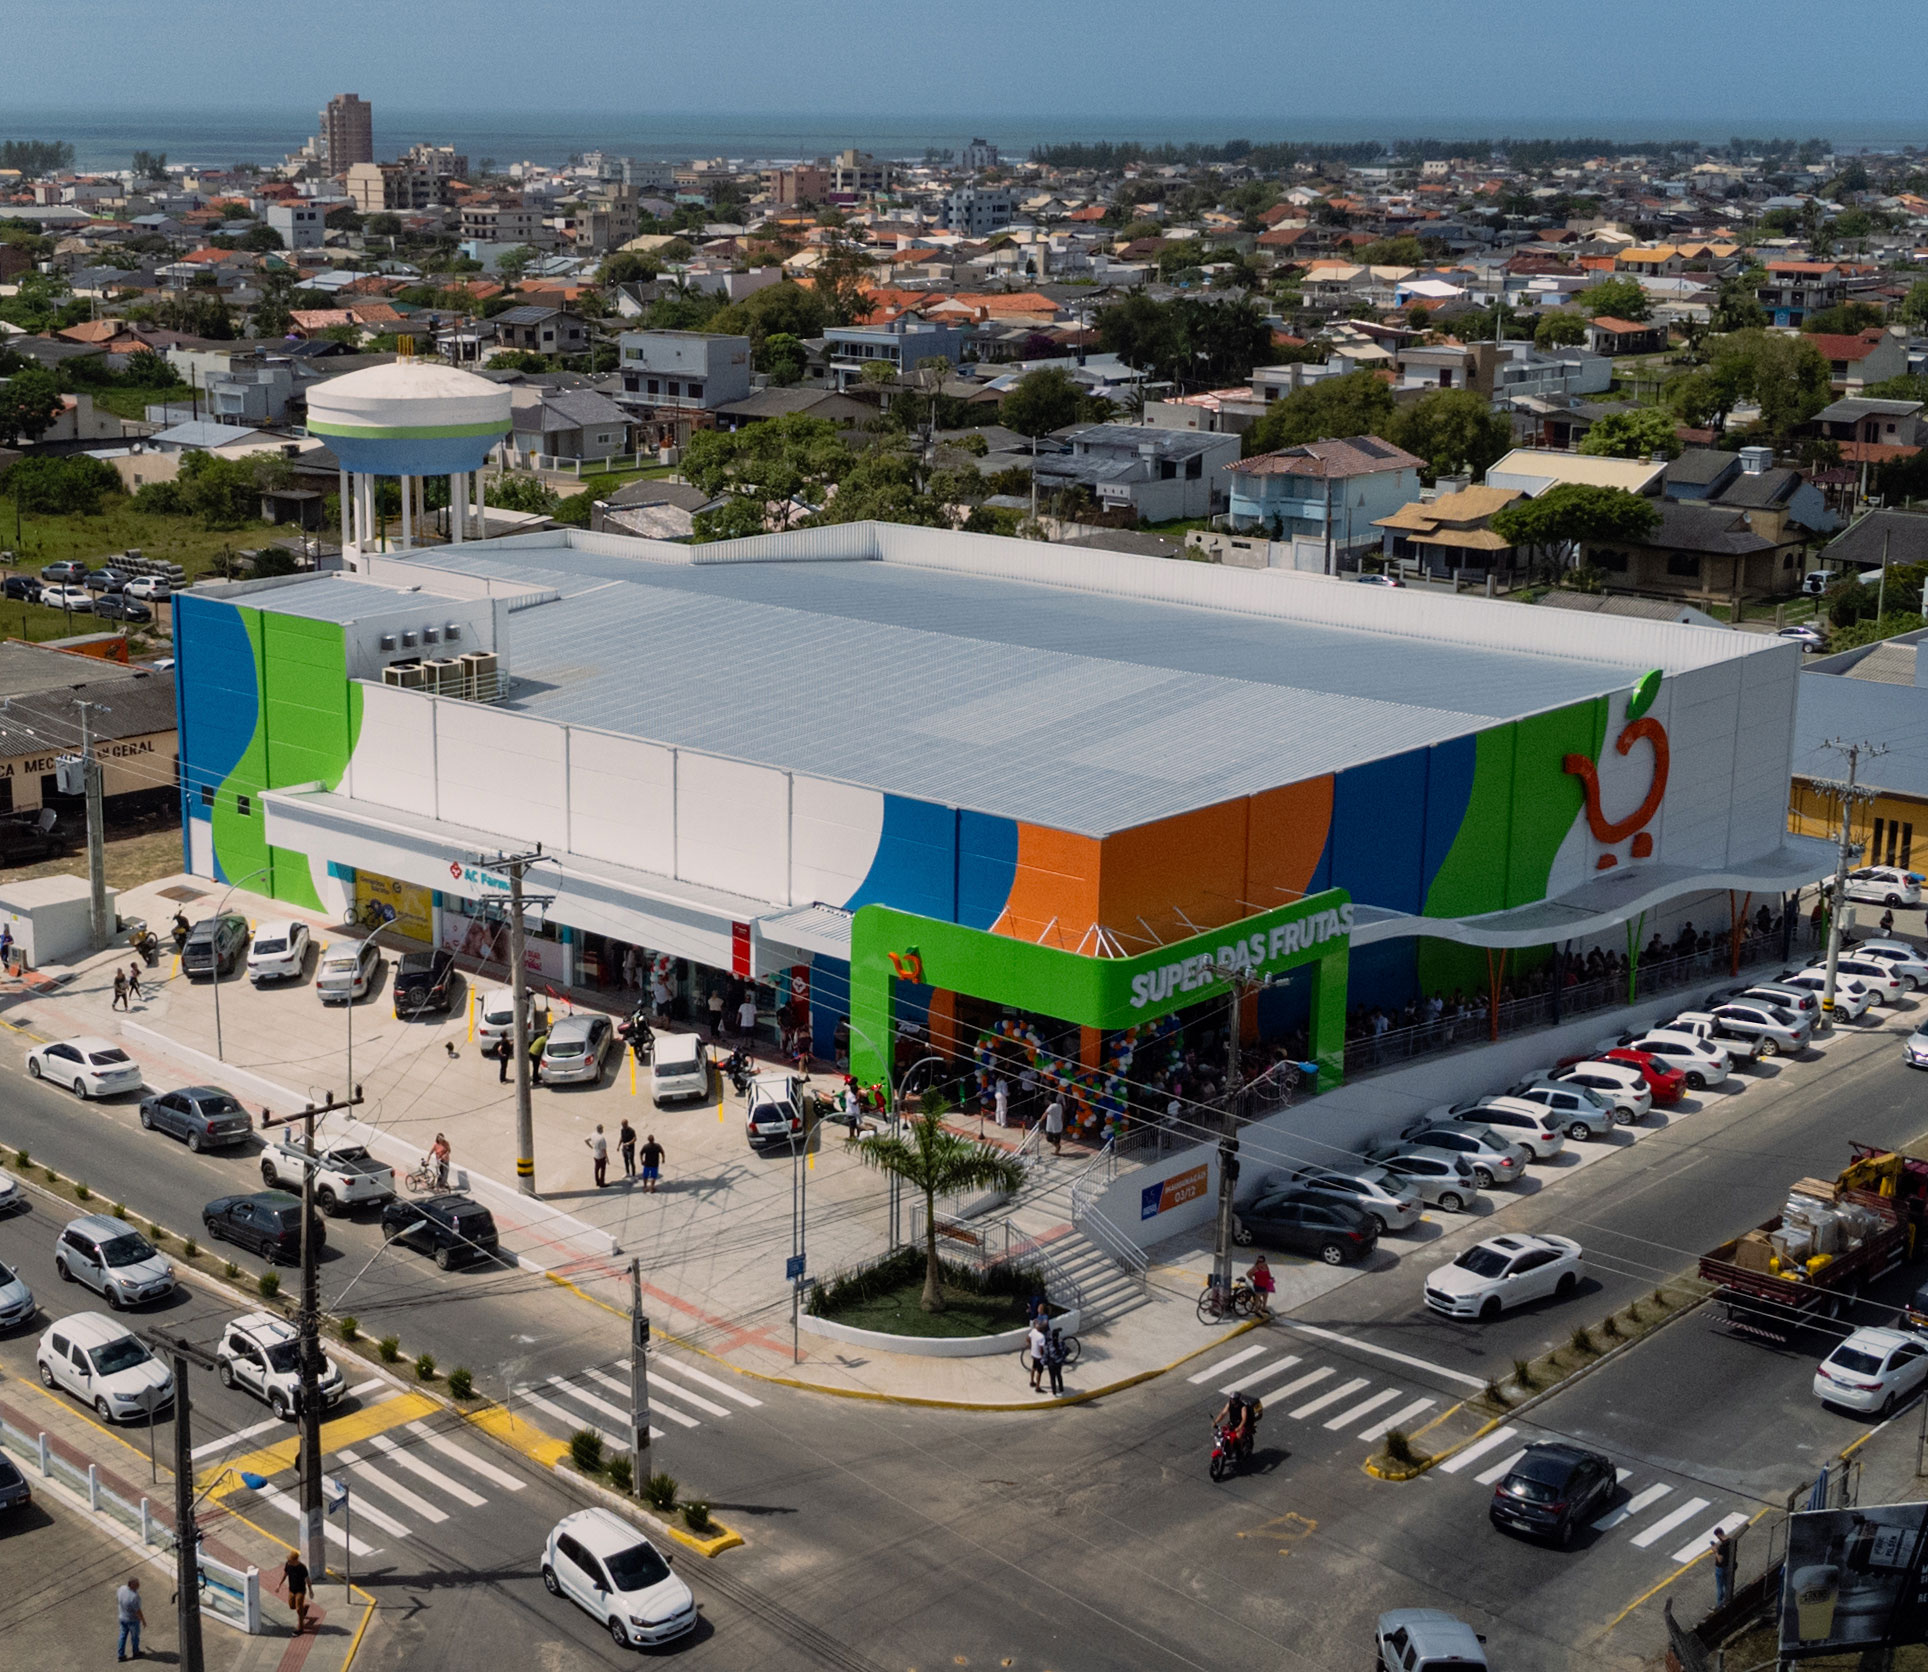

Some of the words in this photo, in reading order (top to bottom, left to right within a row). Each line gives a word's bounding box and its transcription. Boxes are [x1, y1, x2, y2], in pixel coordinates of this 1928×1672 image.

[112, 740, 155, 758] GERAL
[464, 868, 478, 883] AC
[1130, 953, 1214, 1008] SUPER
[1216, 933, 1266, 979] DAS
[1269, 903, 1354, 960] FRUTAS
